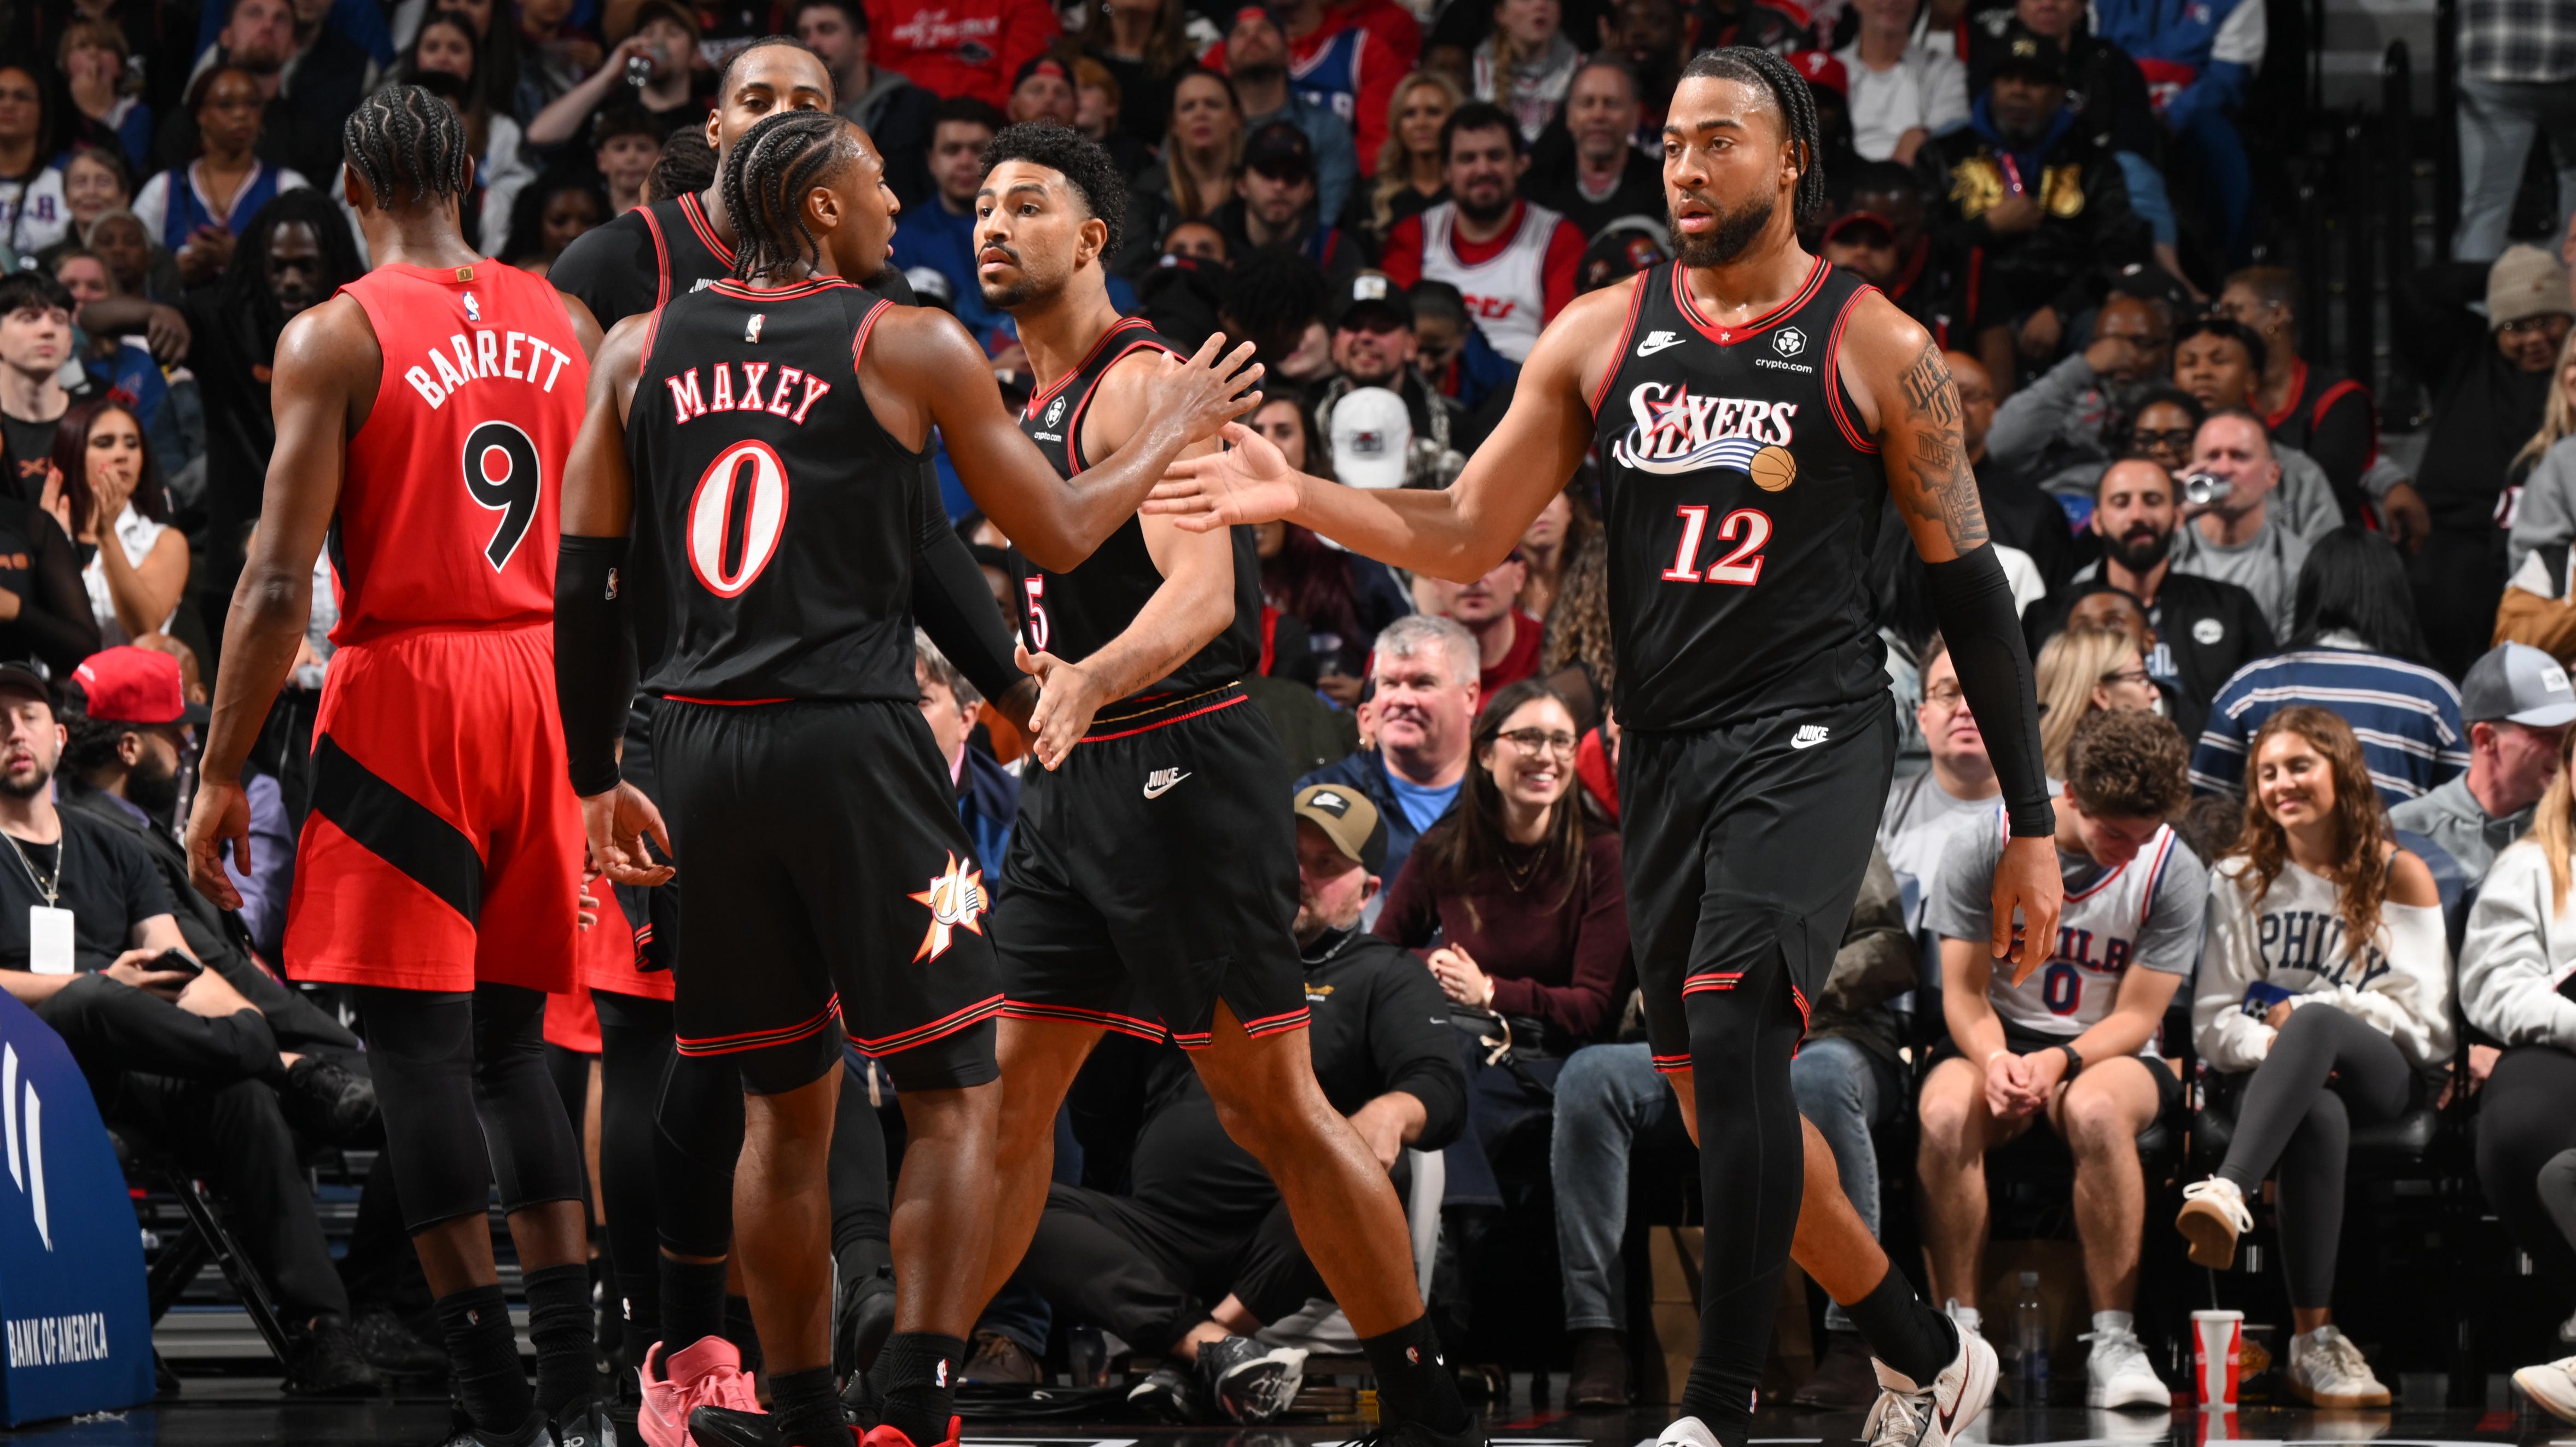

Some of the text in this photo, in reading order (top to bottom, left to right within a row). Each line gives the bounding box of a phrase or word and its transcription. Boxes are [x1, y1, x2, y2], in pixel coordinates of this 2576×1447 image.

[1644, 330, 1677, 347] NIKE
[1755, 357, 1813, 374] crypto.com
[404, 329, 571, 410] BARRETT
[665, 361, 831, 425] MAXEY
[1034, 431, 1062, 442] crypto.com
[462, 420, 541, 574] 9
[686, 439, 789, 598] 0
[1661, 505, 1773, 586] 12
[1024, 574, 1049, 651] 5
[1797, 724, 1829, 740] NIKE
[1148, 767, 1179, 787] NIKE
[2042, 963, 2083, 1017] 0
[7, 1312, 108, 1368] BANK OF AMERICA
